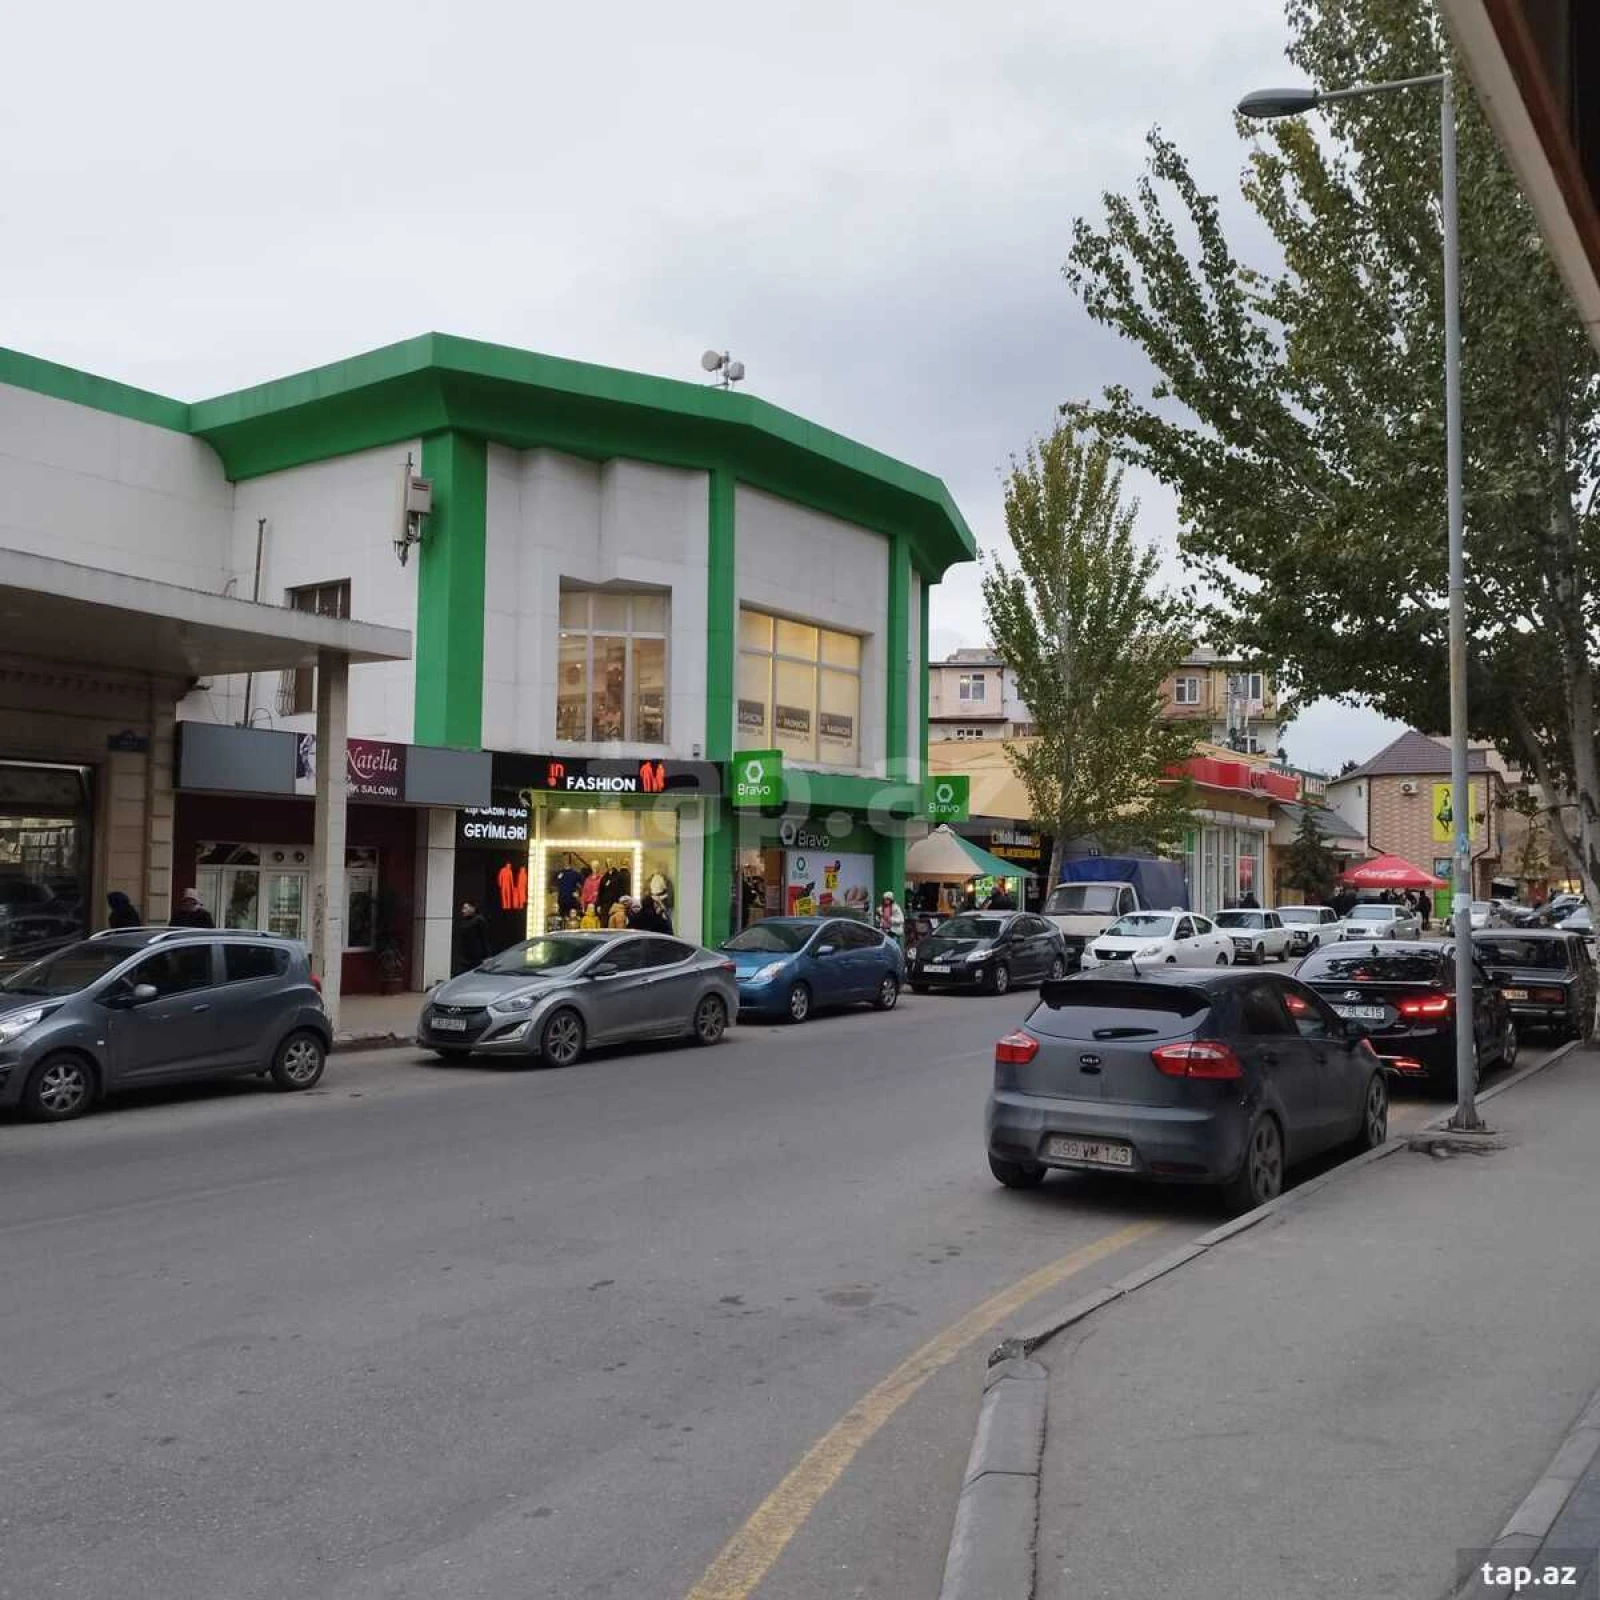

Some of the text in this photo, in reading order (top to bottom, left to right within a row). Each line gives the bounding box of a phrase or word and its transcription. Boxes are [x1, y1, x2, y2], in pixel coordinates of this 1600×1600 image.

[345, 746, 397, 779] Natella
[361, 784, 397, 796] SALONU
[567, 777, 636, 792] FASHION
[737, 783, 770, 796] Bravo
[928, 802, 960, 813] Bravo
[464, 821, 527, 841] GEYİMLƏRİ
[798, 830, 830, 847] Bravo
